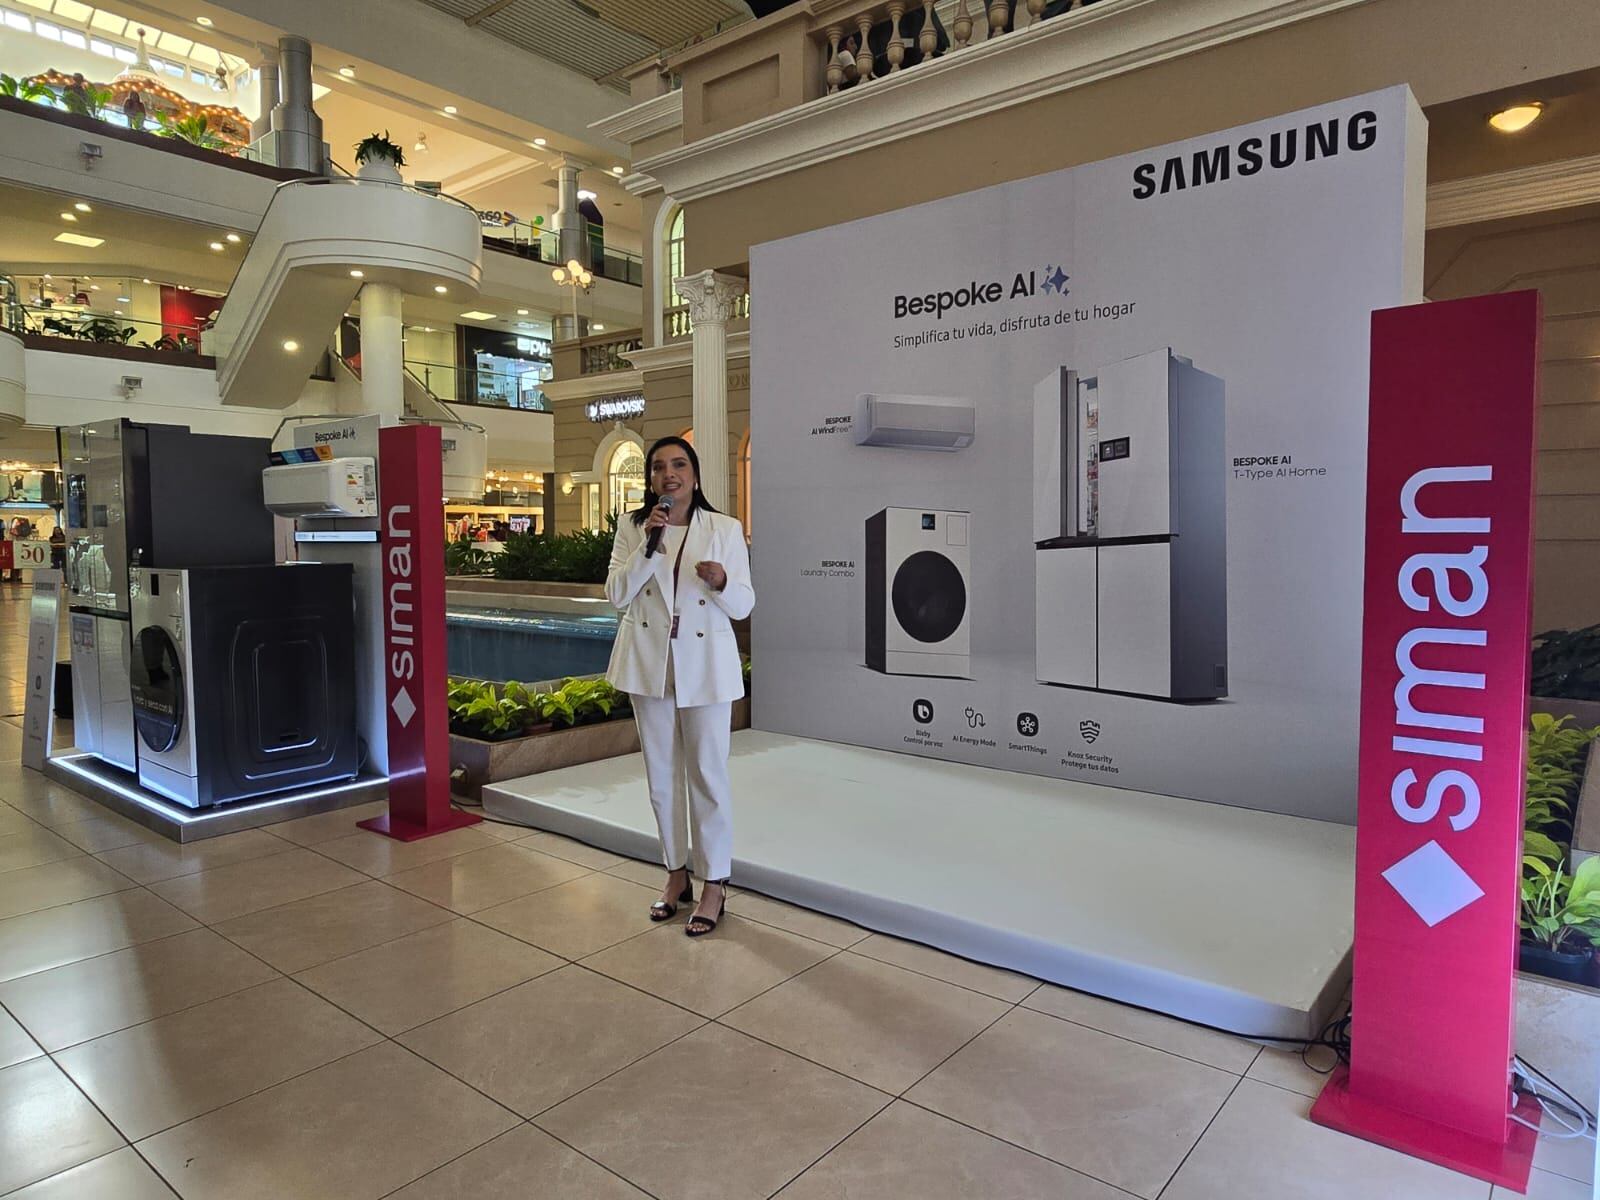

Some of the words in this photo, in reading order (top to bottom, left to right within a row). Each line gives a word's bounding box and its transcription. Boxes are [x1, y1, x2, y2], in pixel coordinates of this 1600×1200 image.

[1132, 110, 1378, 200] SAMSUNG
[893, 281, 1003, 320] Bespoke
[1009, 270, 1036, 300] AI
[893, 330, 950, 349] Simplifica
[952, 327, 966, 341] tu
[967, 322, 997, 338] vida,
[999, 314, 1051, 333] disfruta
[1054, 309, 1072, 325] de
[1074, 308, 1090, 322] tu
[1093, 301, 1137, 321] hogar
[825, 415, 852, 425] BESPOKE
[315, 430, 341, 444] Bespoke
[342, 428, 349, 439] AI
[1233, 456, 1279, 467] BESPOKE
[1281, 455, 1291, 465] AI
[1233, 469, 1274, 480] T-Type
[1276, 468, 1287, 478] AI
[1289, 467, 1327, 477] Home
[20, 543, 45, 564] 50
[821, 560, 848, 568] BESPOKE
[800, 568, 827, 579] Laundry
[828, 569, 855, 578] Combo
[387, 504, 415, 681] siman
[1390, 464, 1493, 832] siman
[959, 735, 979, 746] Energy
[979, 738, 997, 747] Mode
[1008, 742, 1048, 755] SmartThings
[1067, 750, 1084, 760] Knox
[1084, 752, 1113, 764] Security
[1061, 758, 1087, 770] Protege
[1087, 762, 1099, 771] tus
[1099, 763, 1120, 774] datos
